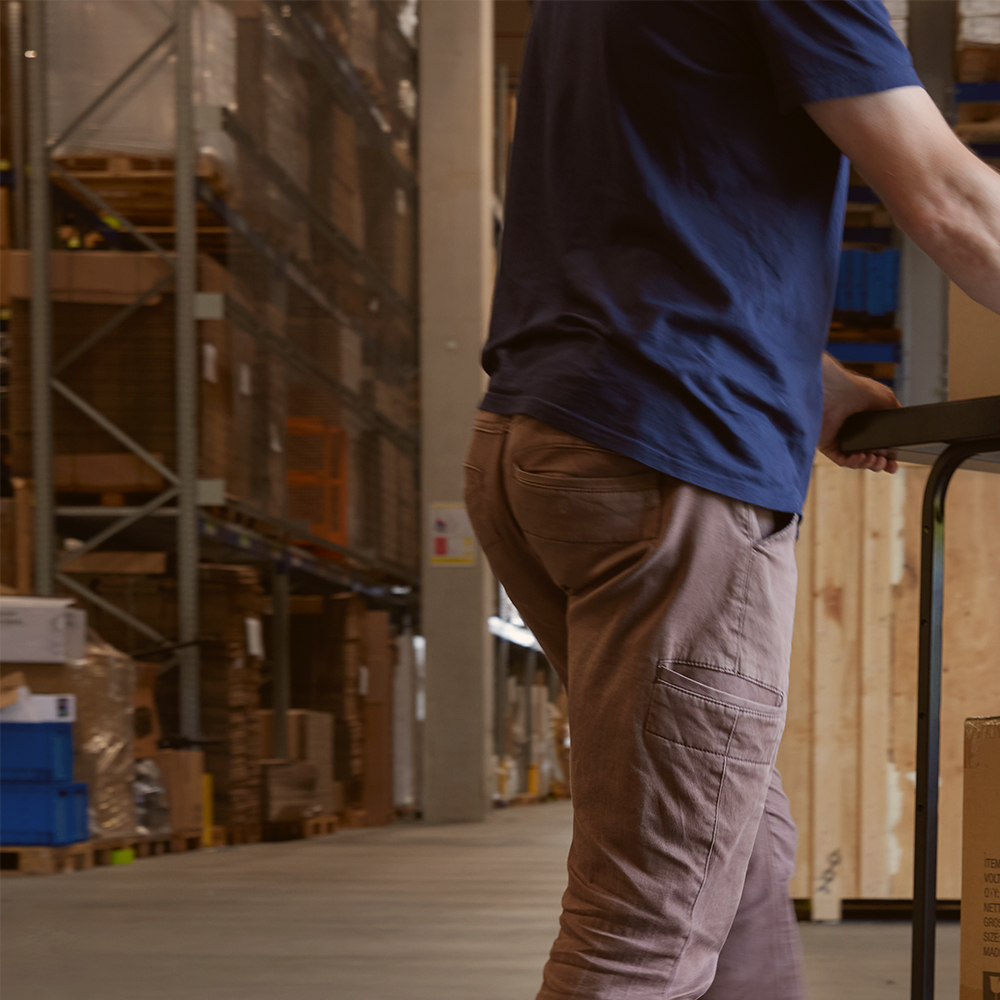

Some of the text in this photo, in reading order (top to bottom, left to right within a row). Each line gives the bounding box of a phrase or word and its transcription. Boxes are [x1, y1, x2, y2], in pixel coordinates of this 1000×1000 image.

[985, 858, 1000, 869] ITEM
[984, 903, 1000, 913] NETT
[983, 932, 1000, 943] SIZE:
